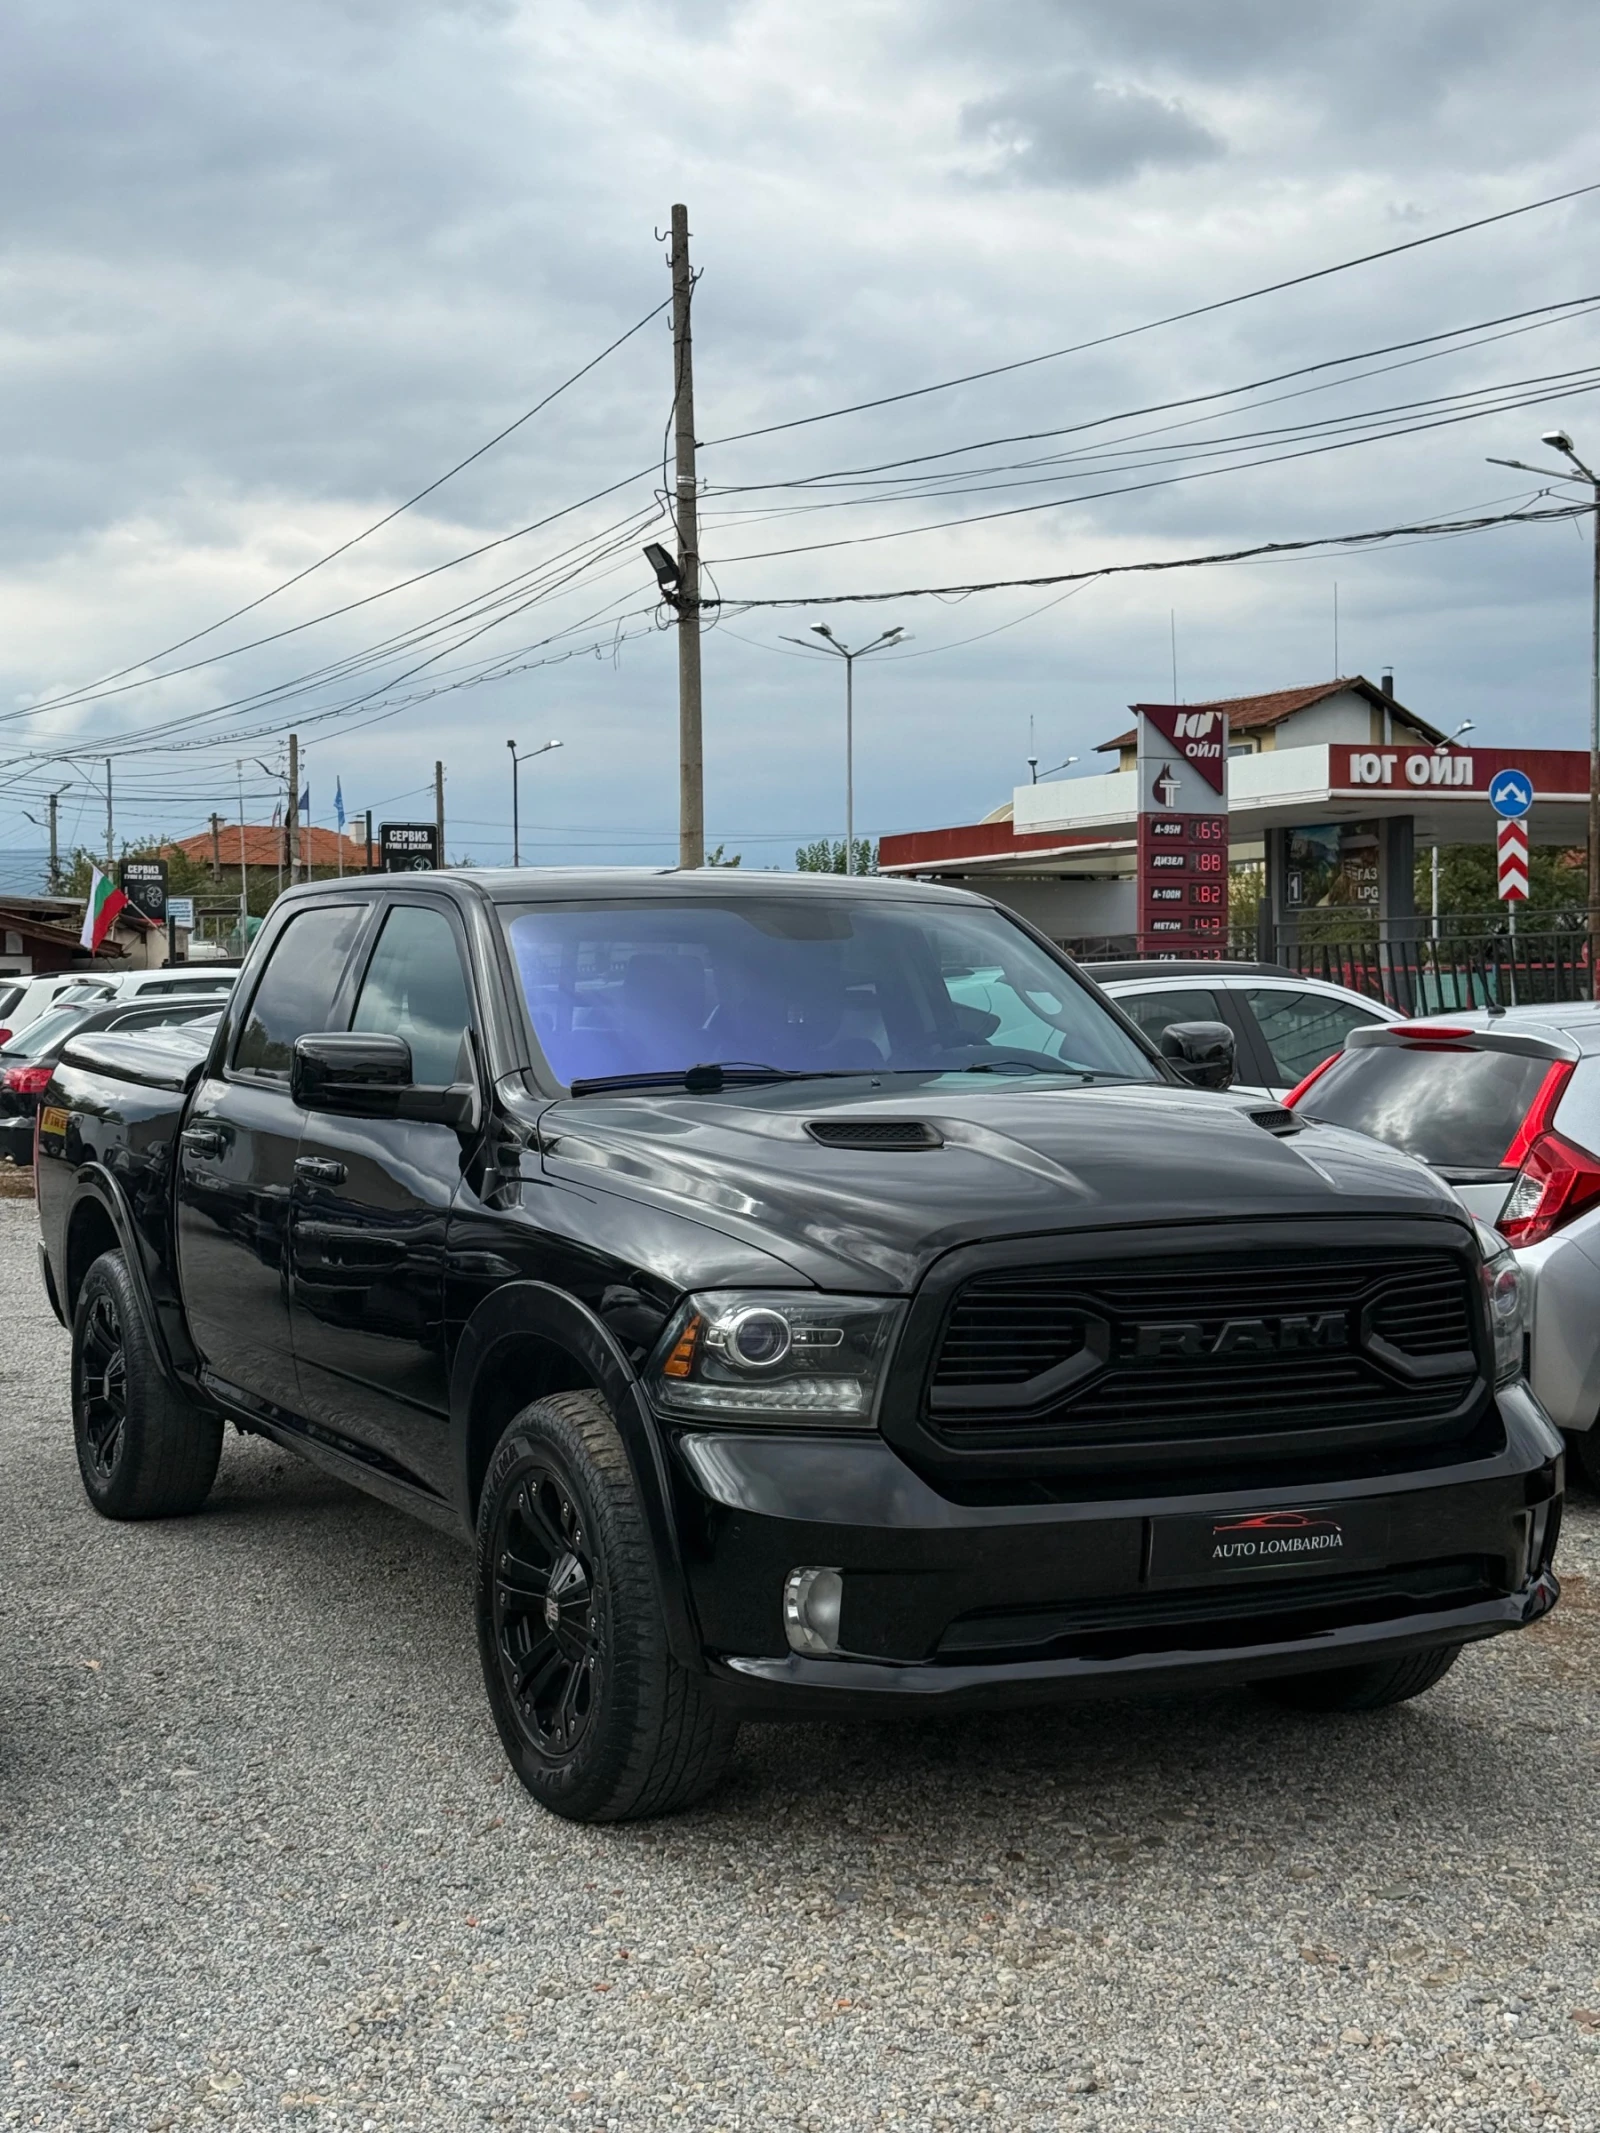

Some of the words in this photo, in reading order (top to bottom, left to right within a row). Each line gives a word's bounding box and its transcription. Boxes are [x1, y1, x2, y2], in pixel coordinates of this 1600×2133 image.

[1185, 741, 1221, 758] ОЙЛ
[1349, 753, 1398, 784] ЮГ
[1405, 748, 1473, 785] ОЙЛ
[389, 830, 428, 842] СЕРВИЗ
[1153, 856, 1184, 867] ДИЗЕЛ
[127, 864, 160, 875] СЕРВИЗ
[1357, 867, 1378, 881] ГАЗ
[1291, 876, 1299, 899] 1
[1357, 886, 1379, 899] LPG
[1153, 922, 1181, 930] МЕТАН
[1136, 1313, 1347, 1356] RAM
[1212, 1542, 1256, 1558] AUTO
[1259, 1534, 1343, 1554] LOMBARDIA
